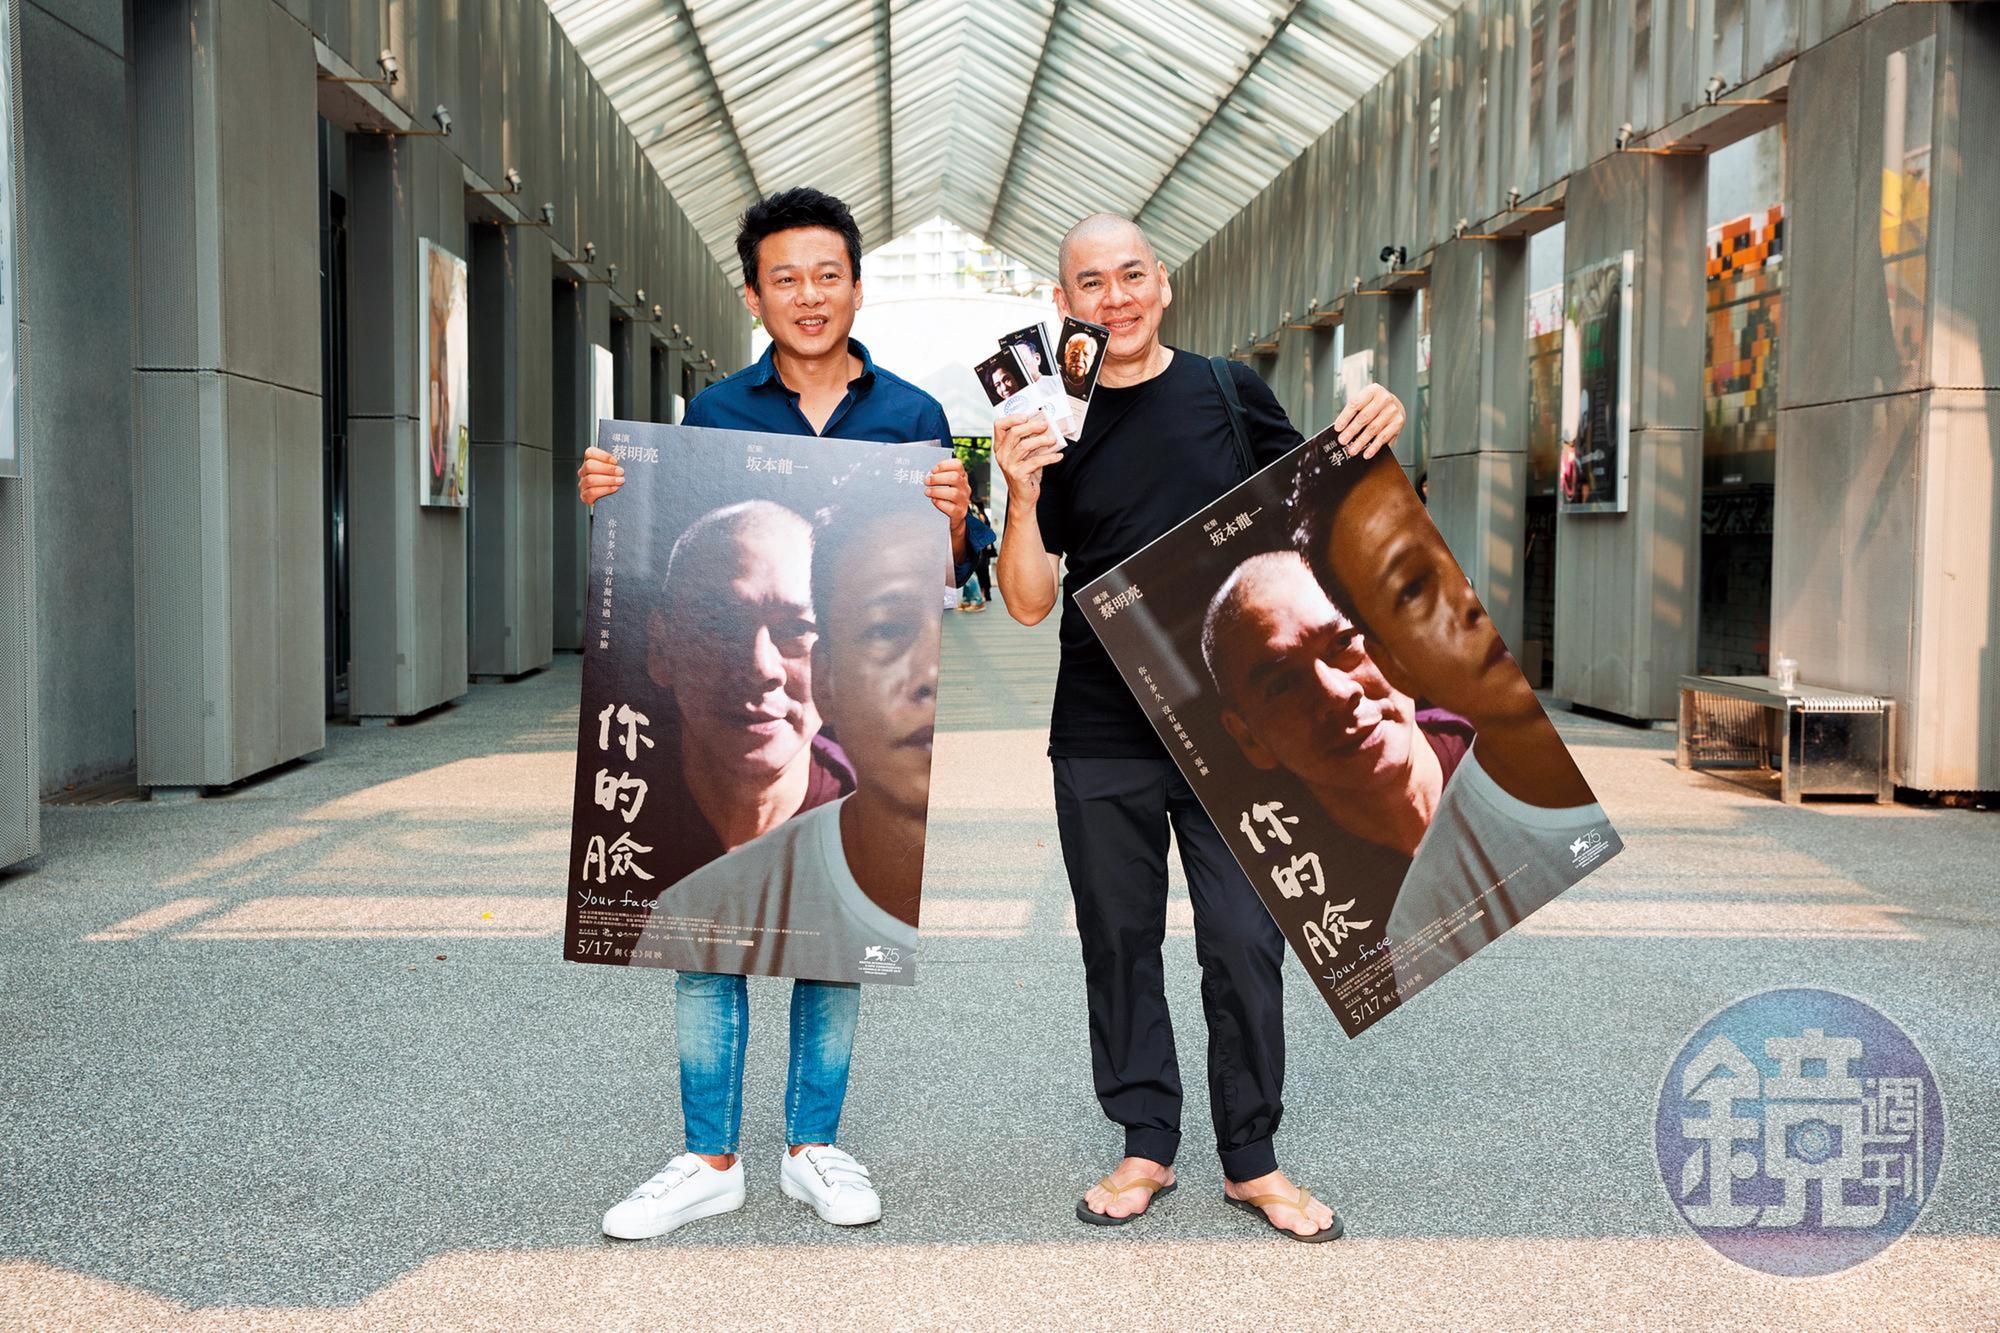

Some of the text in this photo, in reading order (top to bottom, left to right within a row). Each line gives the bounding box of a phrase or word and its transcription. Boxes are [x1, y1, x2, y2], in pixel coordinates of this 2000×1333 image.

[611, 444, 659, 463] 蔡明亮
[745, 456, 808, 475] 坂本龍一
[1209, 506, 1263, 547] 坂本龍一
[1098, 584, 1144, 620] 蔡明亮
[582, 703, 656, 884] 你的臉
[1239, 801, 1373, 966] 你的臉
[619, 889, 661, 910] face
[576, 939, 613, 957] 5/17
[1358, 936, 1394, 962] face
[1350, 994, 1381, 1026] 5/17
